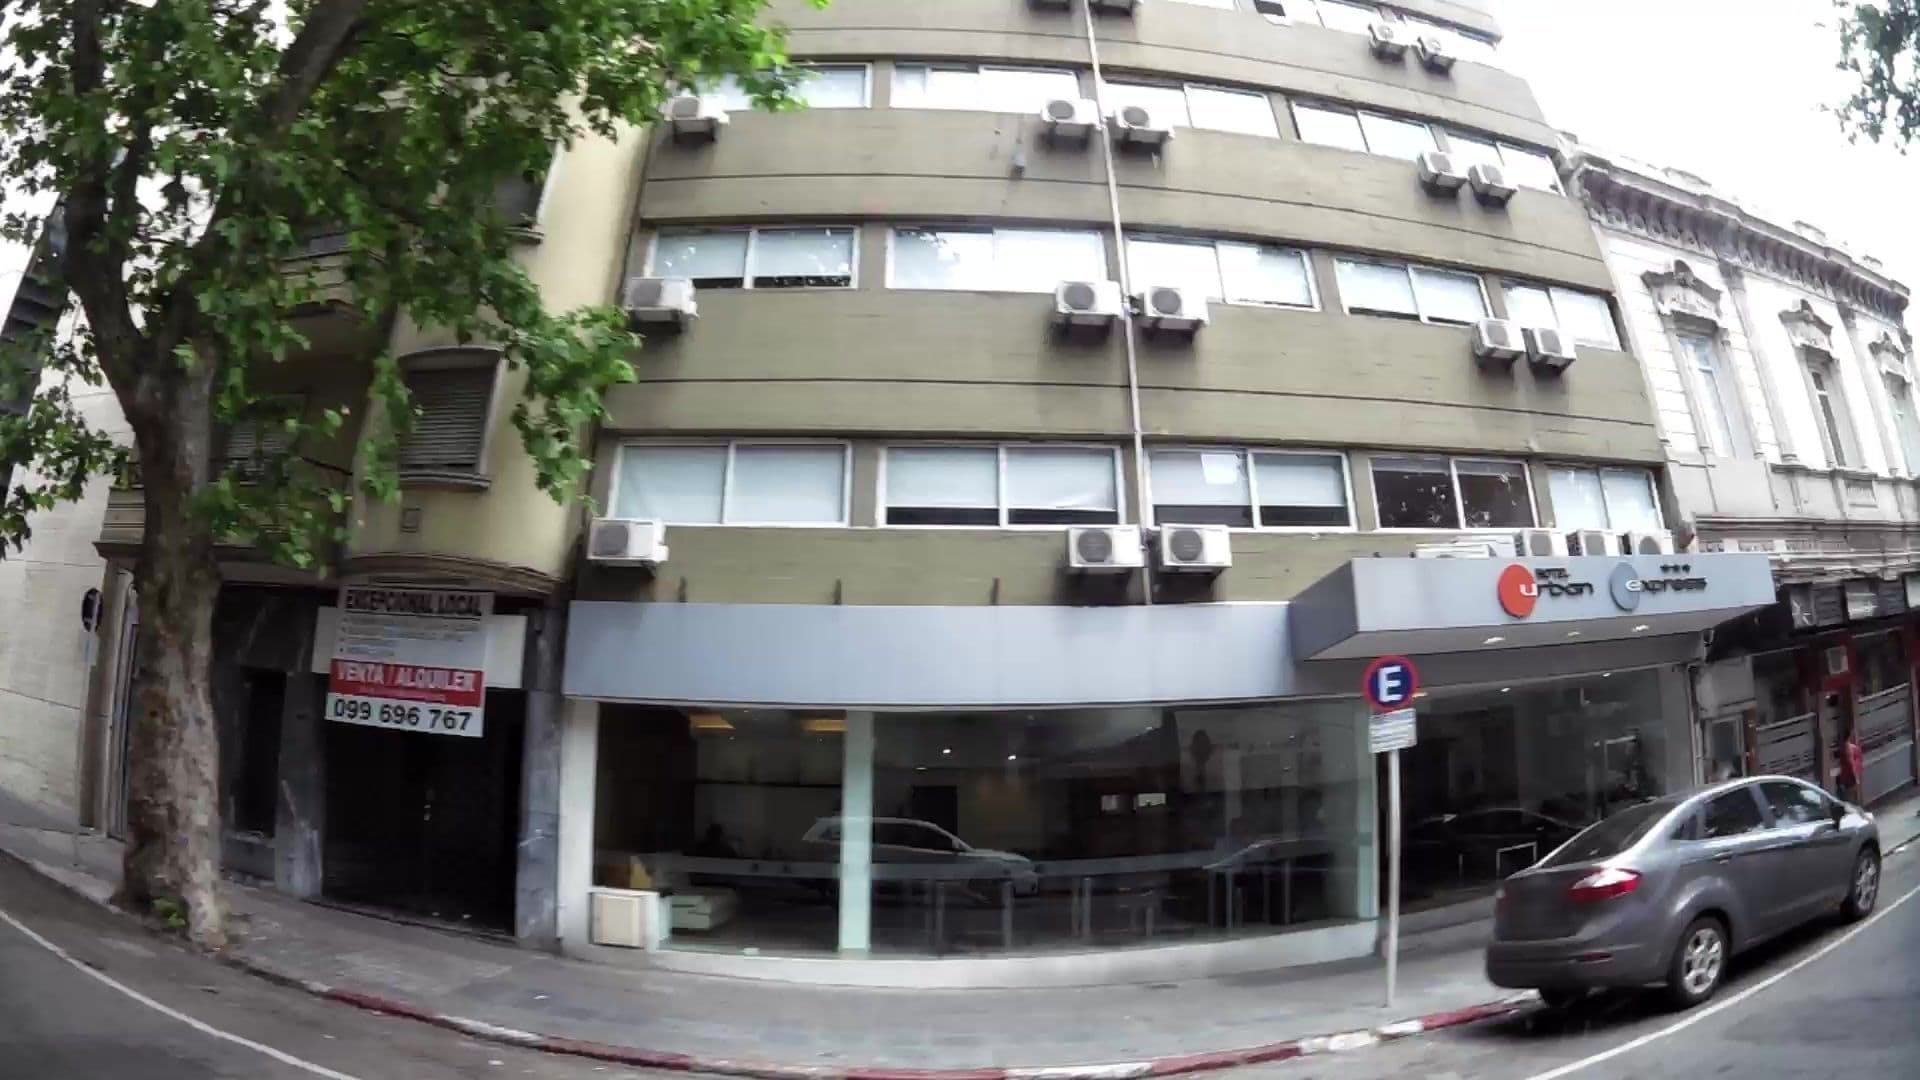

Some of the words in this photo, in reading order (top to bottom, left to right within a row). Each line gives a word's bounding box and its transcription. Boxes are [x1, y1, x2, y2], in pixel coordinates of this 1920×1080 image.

[1520, 581, 1594, 597] urban
[337, 661, 384, 684] VENTA
[396, 667, 476, 692] ALQUILER
[1378, 665, 1402, 702] E
[334, 698, 371, 720] 099
[379, 703, 421, 726] 696
[428, 708, 472, 731] 767
